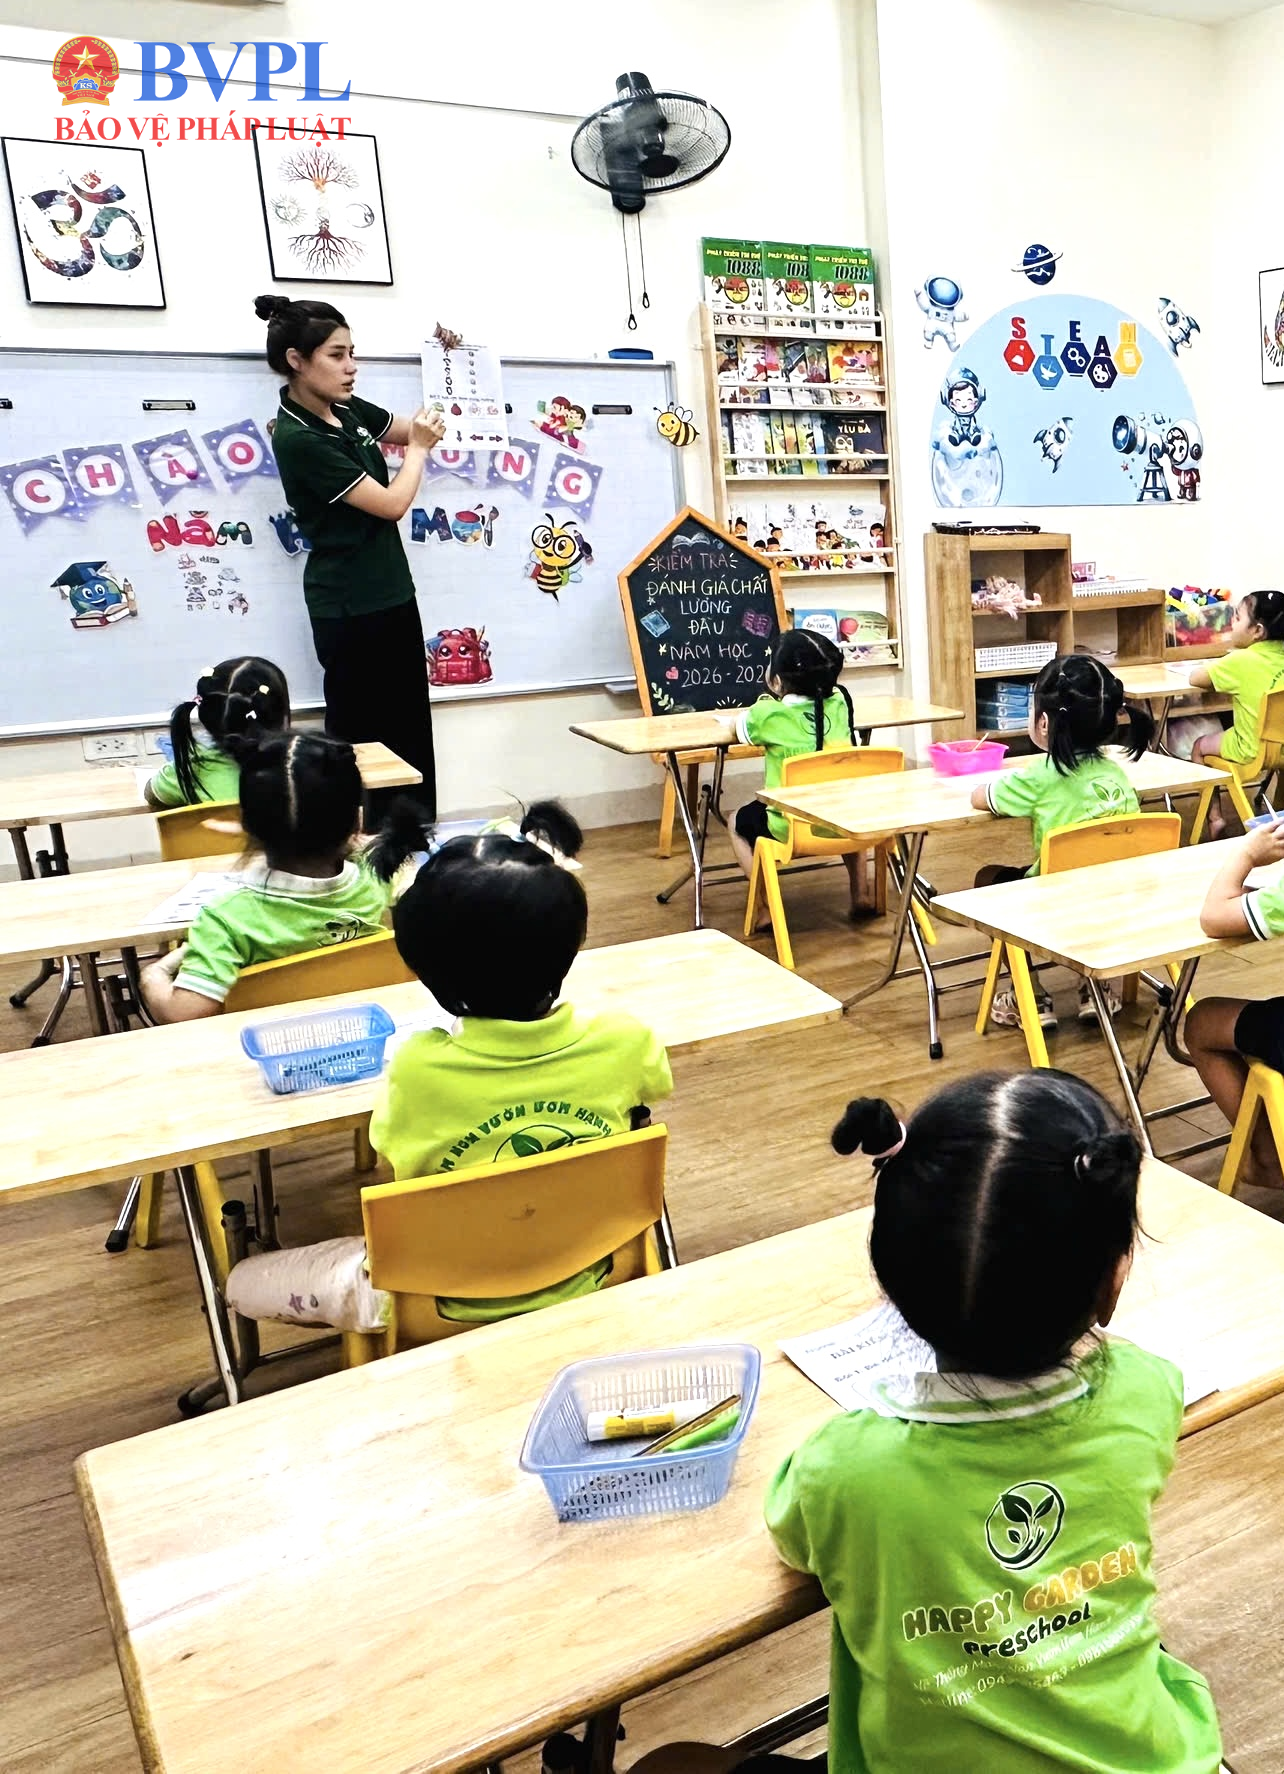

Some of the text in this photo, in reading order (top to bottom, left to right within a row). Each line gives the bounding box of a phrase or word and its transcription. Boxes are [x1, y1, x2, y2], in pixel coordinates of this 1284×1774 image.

[727, 259, 761, 276] 1088
[786, 261, 809, 278] 108
[835, 265, 868, 280] 1088
[1011, 316, 1137, 357] STEAM
[25, 441, 255, 504] CHÀO
[655, 549, 730, 571] KIỂM TRA
[645, 573, 768, 596] ĐÁNH GIÁ CHẤT
[719, 643, 753, 662] HỌC
[681, 669, 722, 688] 2026
[735, 665, 764, 685] 202
[902, 1541, 1138, 1642] HAPPY GARDEN
